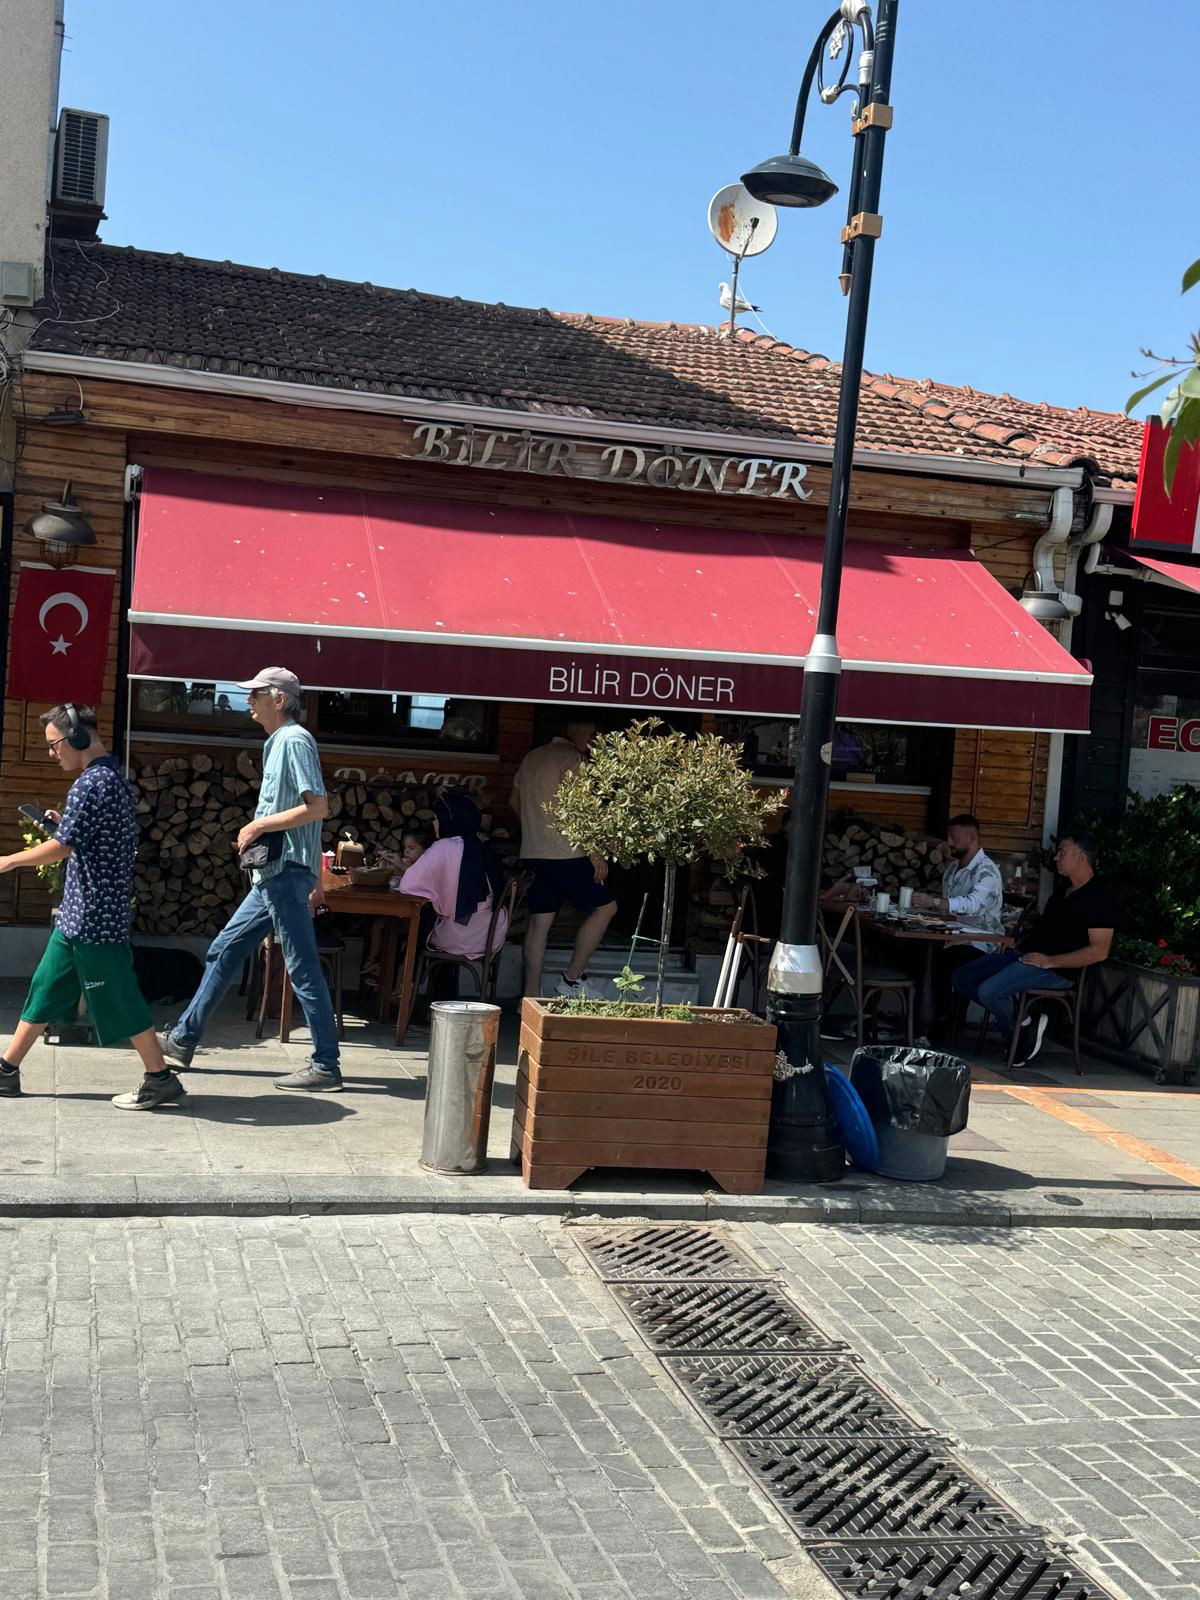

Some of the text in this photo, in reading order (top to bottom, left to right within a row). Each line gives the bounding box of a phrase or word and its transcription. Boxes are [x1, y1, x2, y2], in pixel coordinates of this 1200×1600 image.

[602, 444, 813, 500] DÖNER
[550, 661, 735, 703] BİLİR DÖNER
[632, 1075, 682, 1091] 2020
